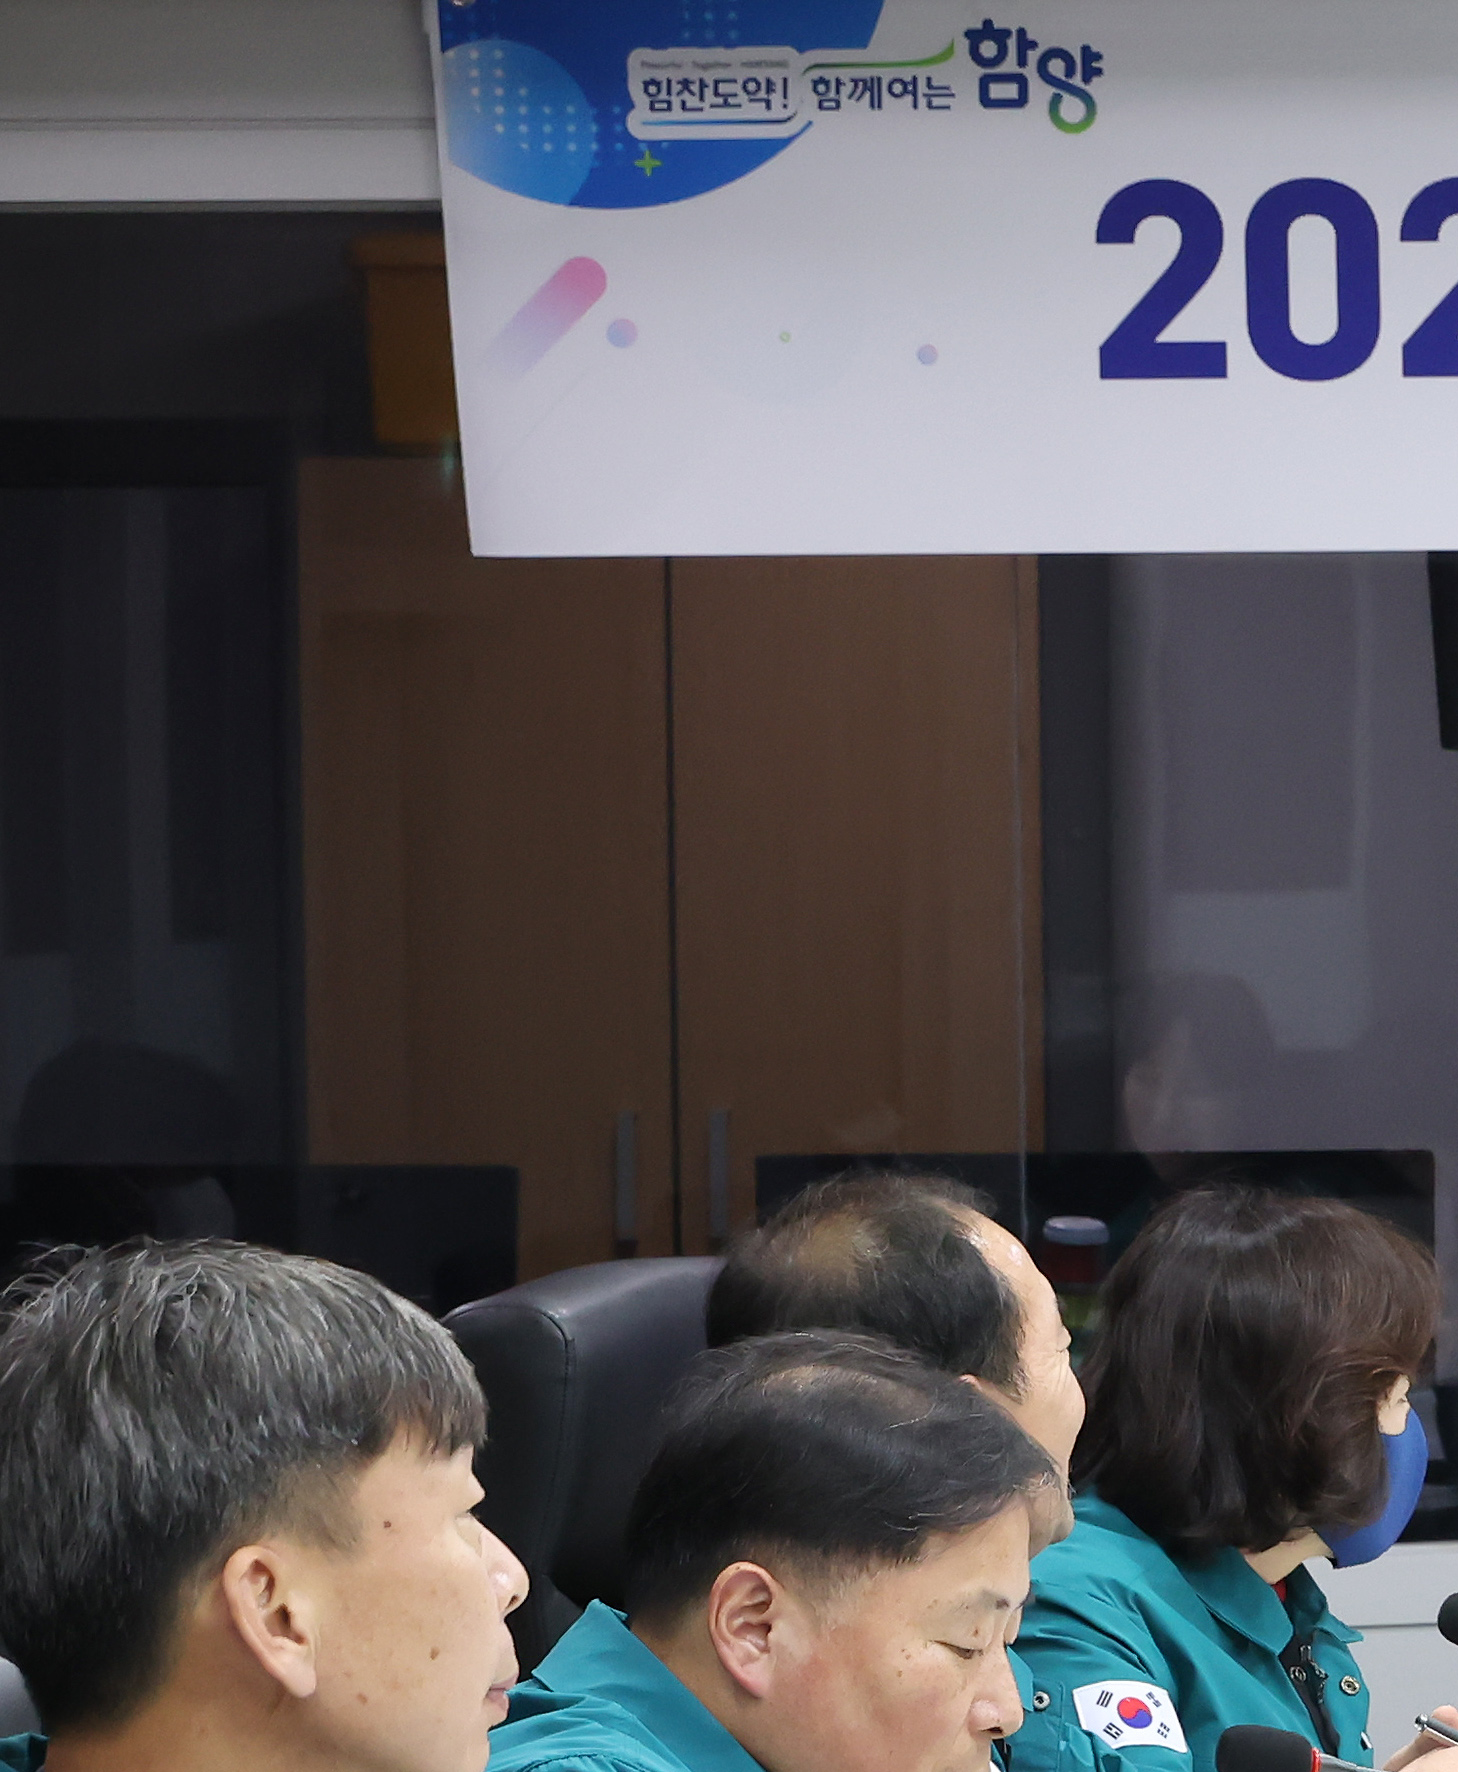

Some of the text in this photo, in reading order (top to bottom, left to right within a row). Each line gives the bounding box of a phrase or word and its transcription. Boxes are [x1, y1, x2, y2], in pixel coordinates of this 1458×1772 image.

[641, 17, 1104, 134] 힘찬도약! 함께여는 함양
